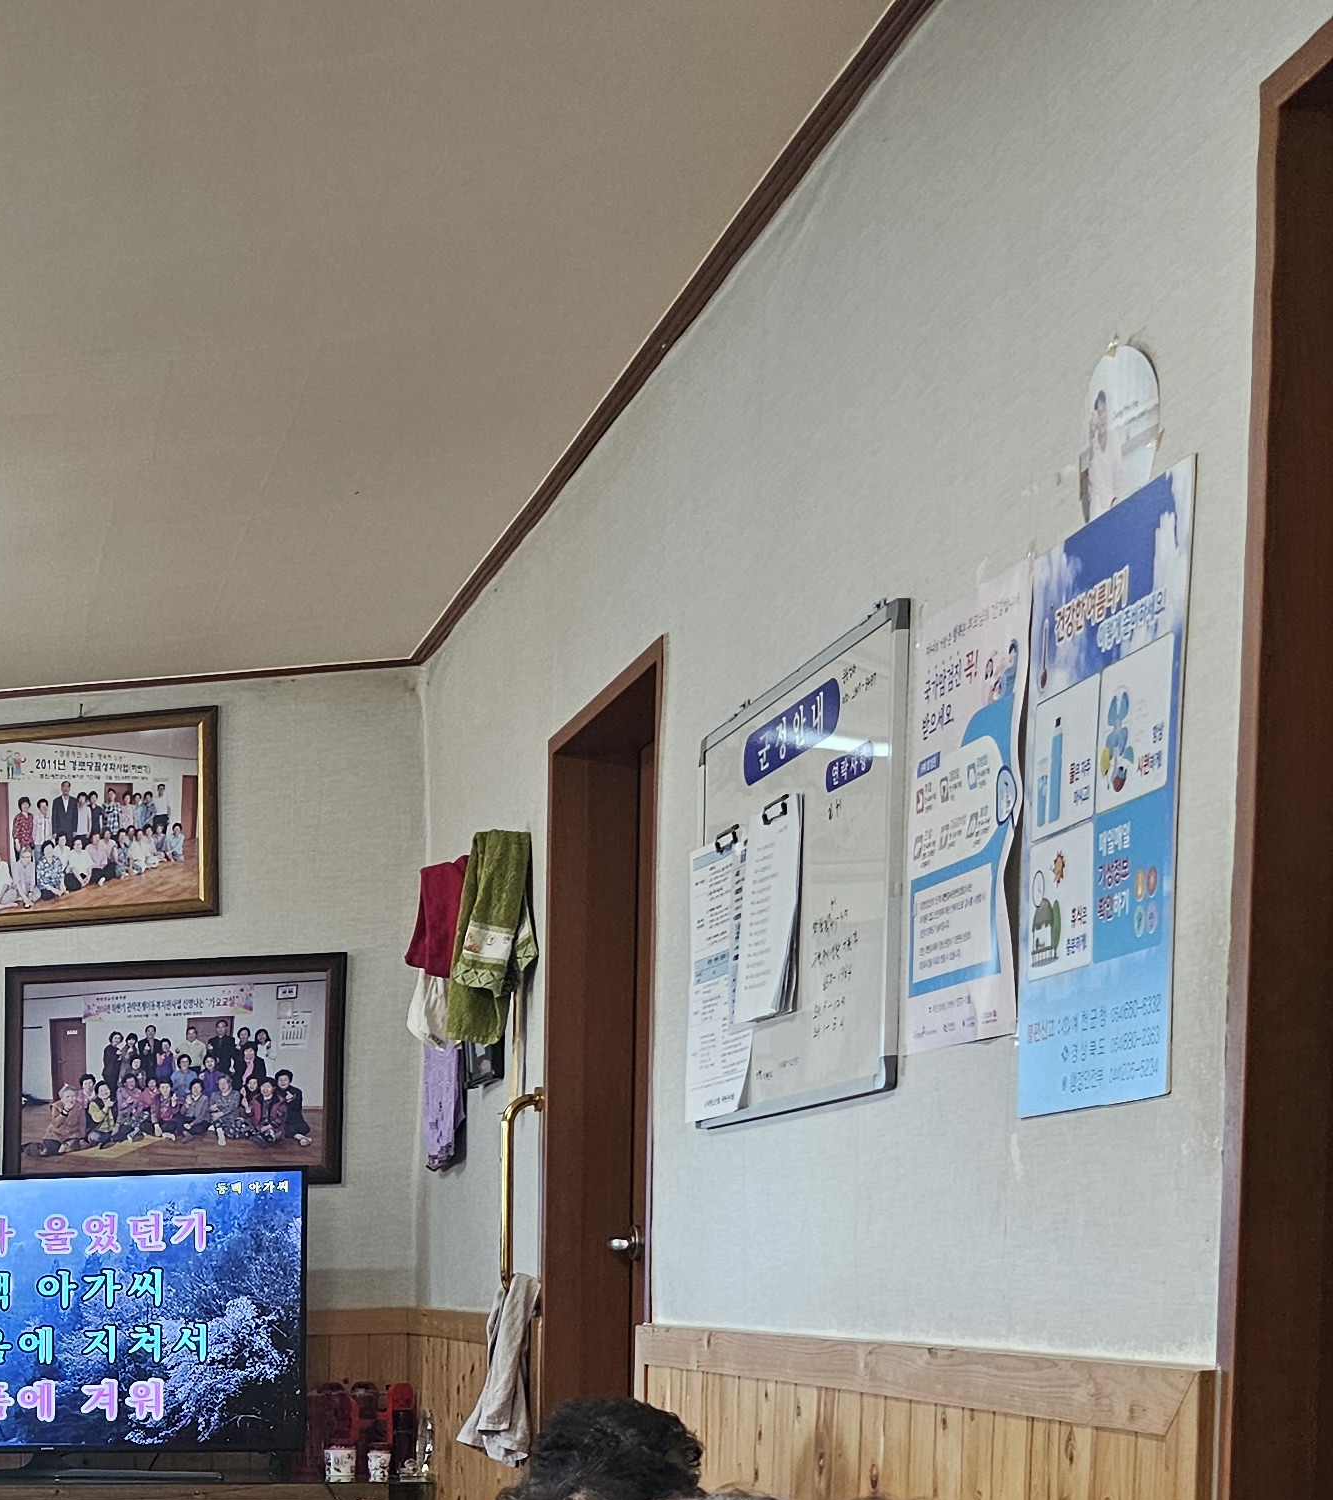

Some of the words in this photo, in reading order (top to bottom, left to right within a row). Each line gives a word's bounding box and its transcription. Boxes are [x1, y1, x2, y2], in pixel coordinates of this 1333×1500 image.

[1055, 592, 1085, 646] 건강한
[1086, 564, 1130, 626] 여름나기
[924, 658, 962, 705] 국가암검진
[963, 649, 979, 684] 꼭!
[35, 758, 66, 770] 2011년
[1098, 821, 1131, 857] 매일매일
[1097, 855, 1130, 890] 기상정보
[1097, 888, 1130, 923] 확인하기
[1071, 1036, 1106, 1064] 경상북도
[215, 1180, 242, 1196] 동백
[248, 1178, 290, 1195] 아가씨
[36, 1208, 214, 1255] 울었던가
[38, 1267, 165, 1309] 아가씨
[82, 1322, 210, 1364] 지쳐서
[80, 1377, 165, 1421] 겨워
